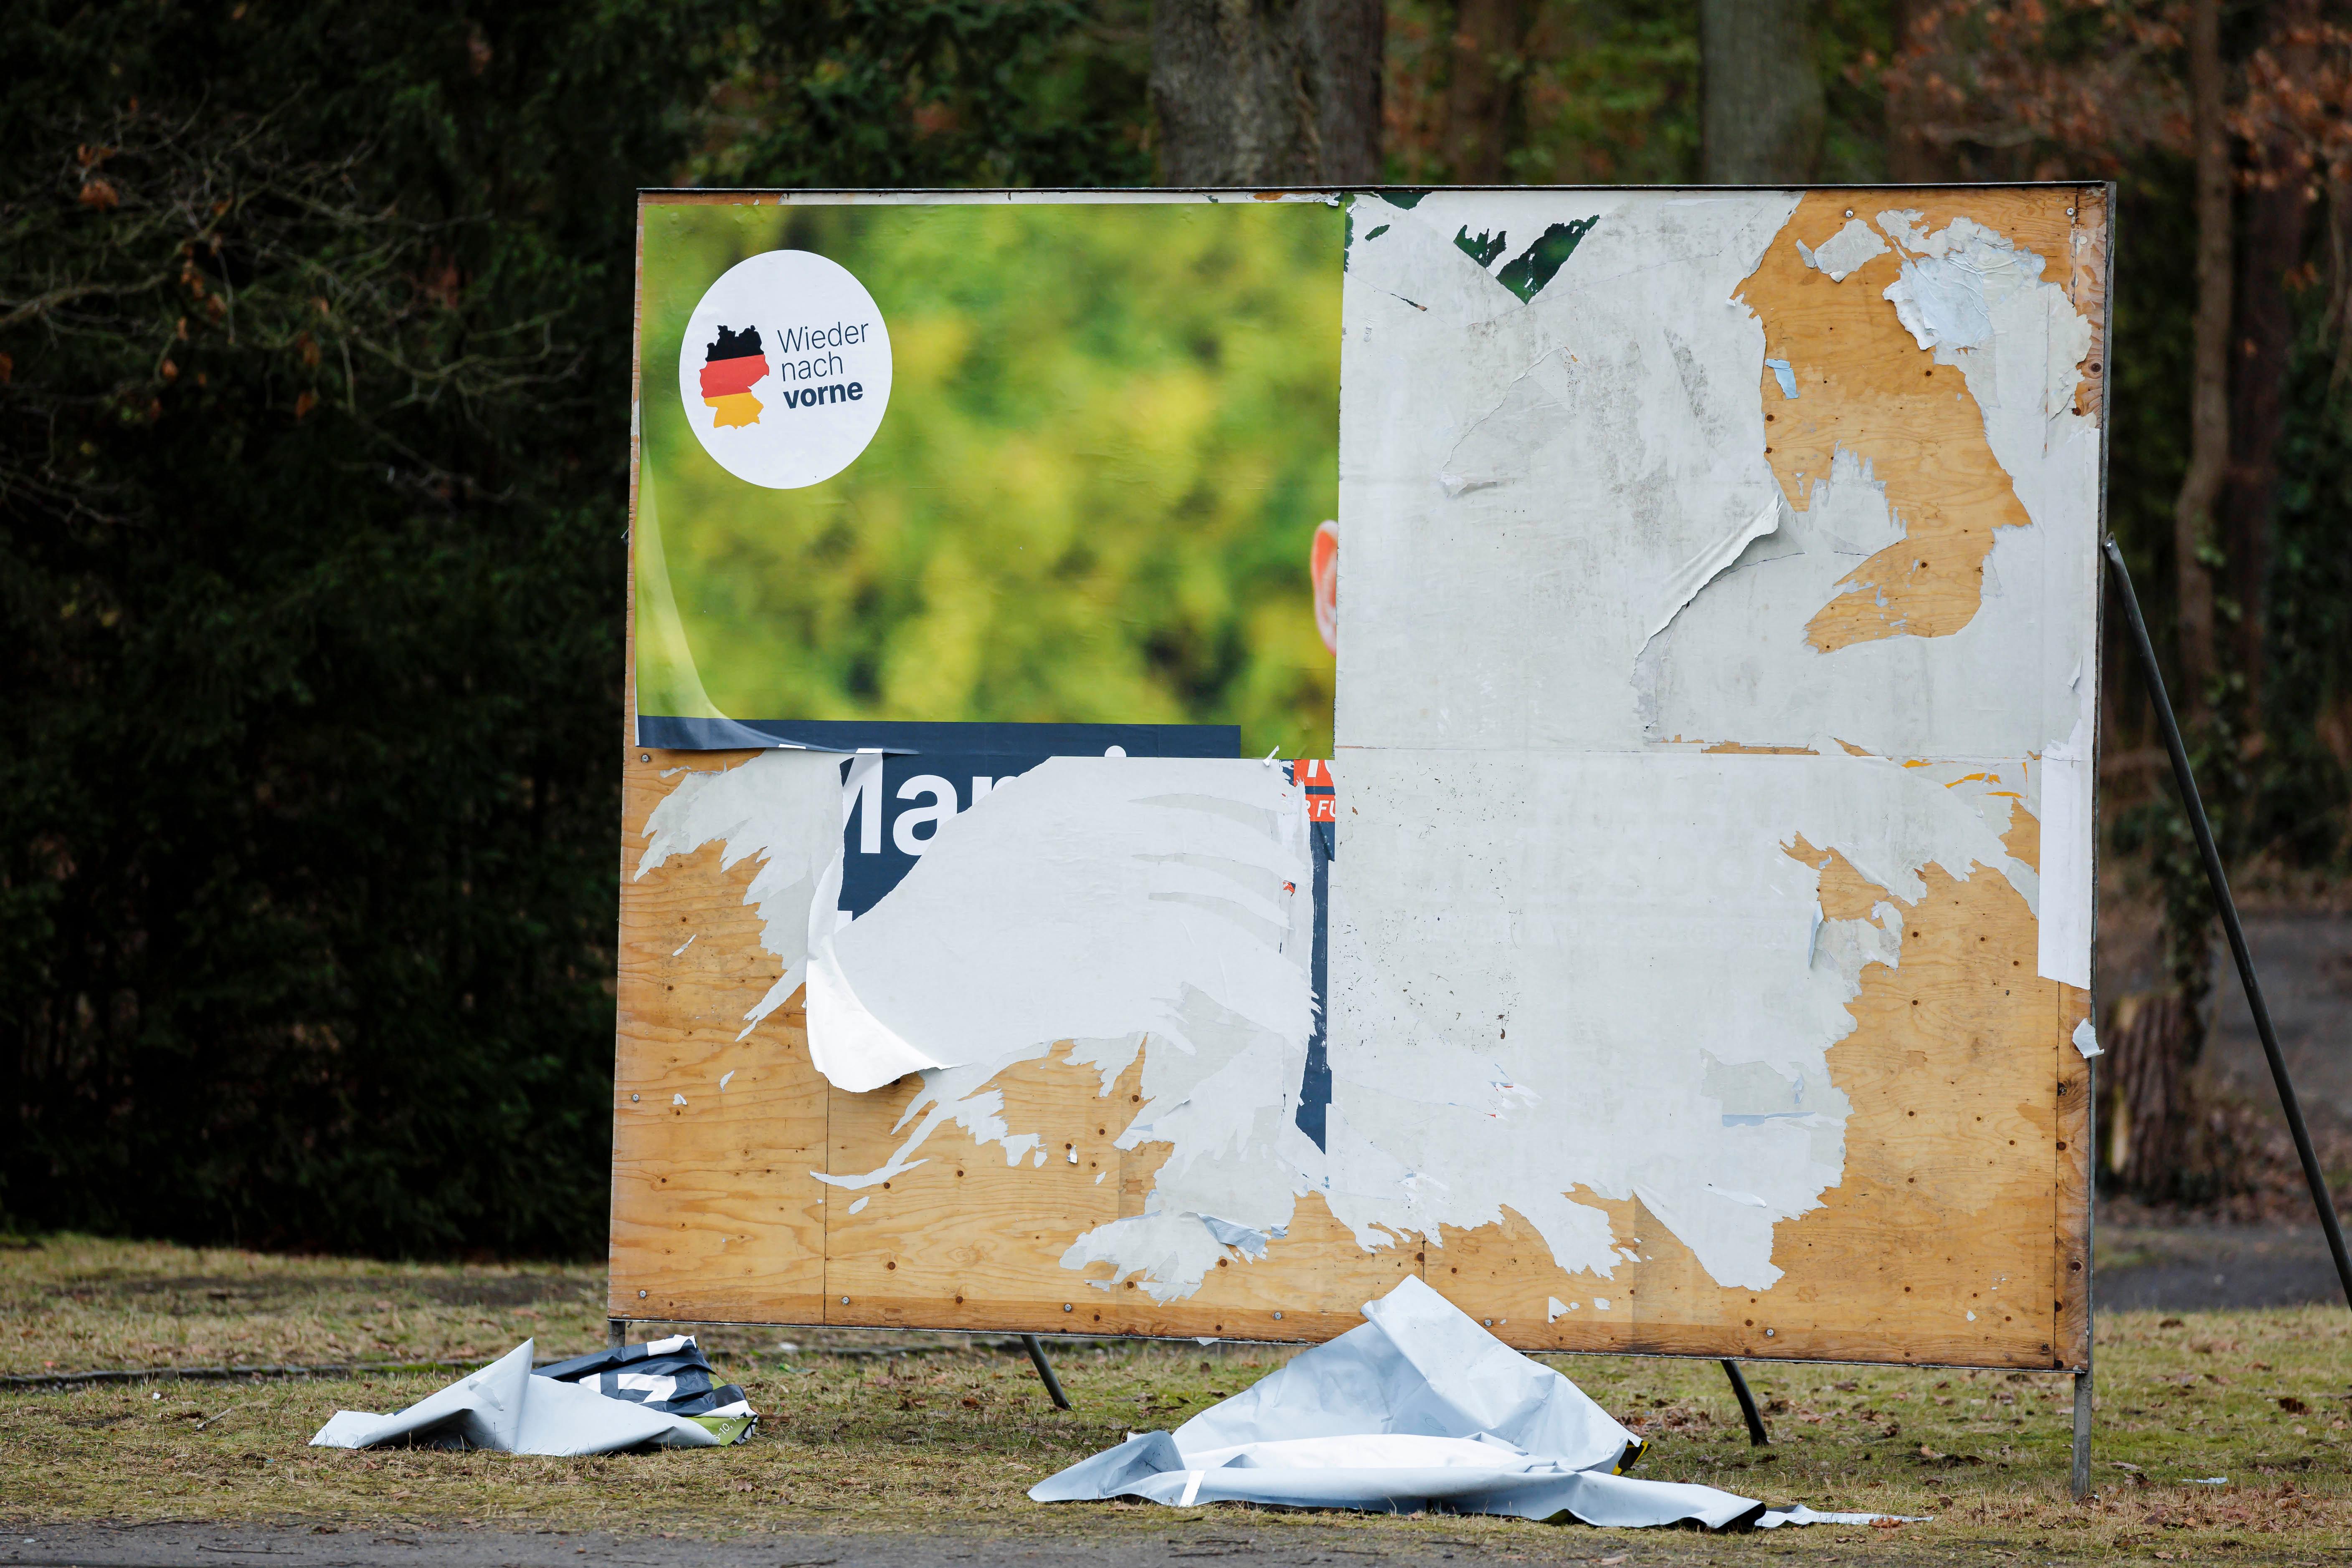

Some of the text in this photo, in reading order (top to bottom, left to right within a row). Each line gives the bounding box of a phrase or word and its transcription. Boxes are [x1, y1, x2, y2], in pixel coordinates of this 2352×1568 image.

[777, 321, 869, 354] Wieder
[781, 351, 843, 382] nach
[783, 381, 863, 409] vorne
